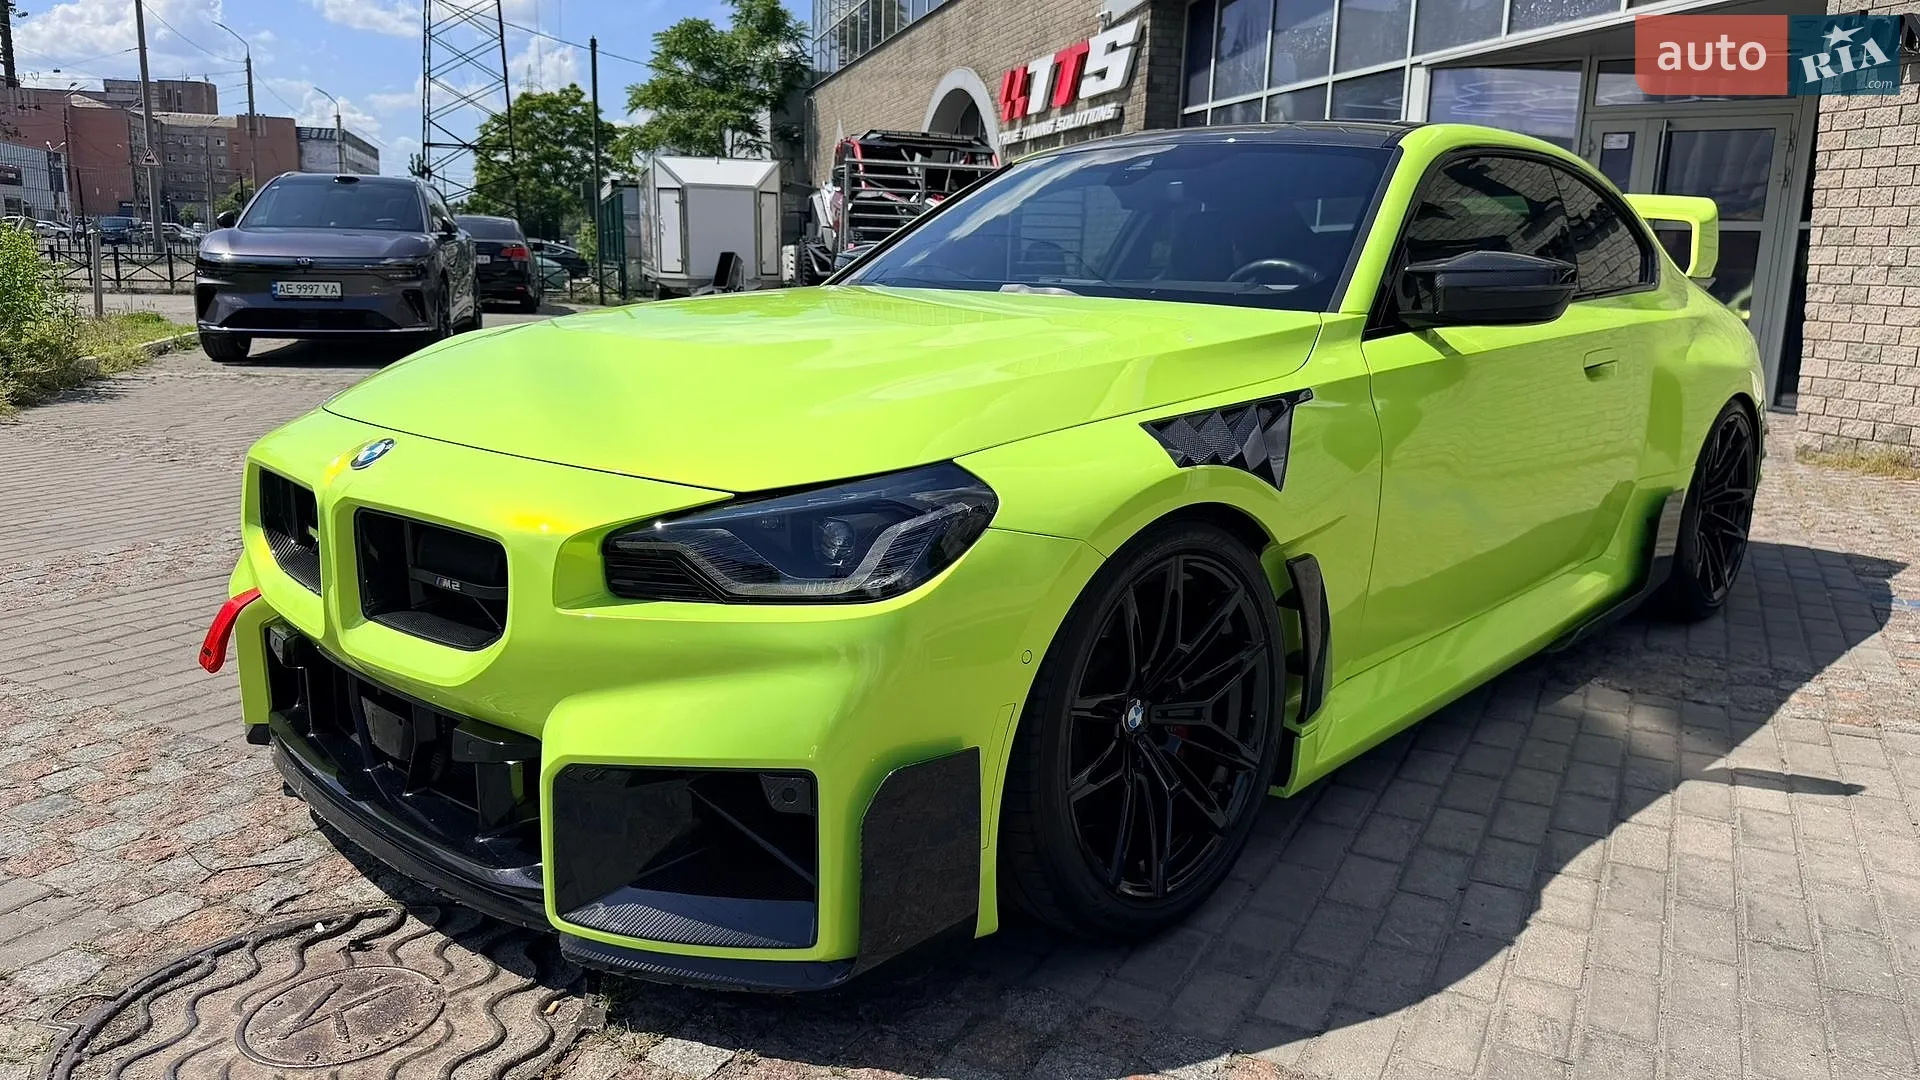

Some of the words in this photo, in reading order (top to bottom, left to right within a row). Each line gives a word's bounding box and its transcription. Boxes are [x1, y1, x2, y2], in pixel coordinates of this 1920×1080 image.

[1055, 102, 1118, 132] SOLUTIONS
[279, 284, 293, 294] AE
[296, 284, 319, 294] 9997
